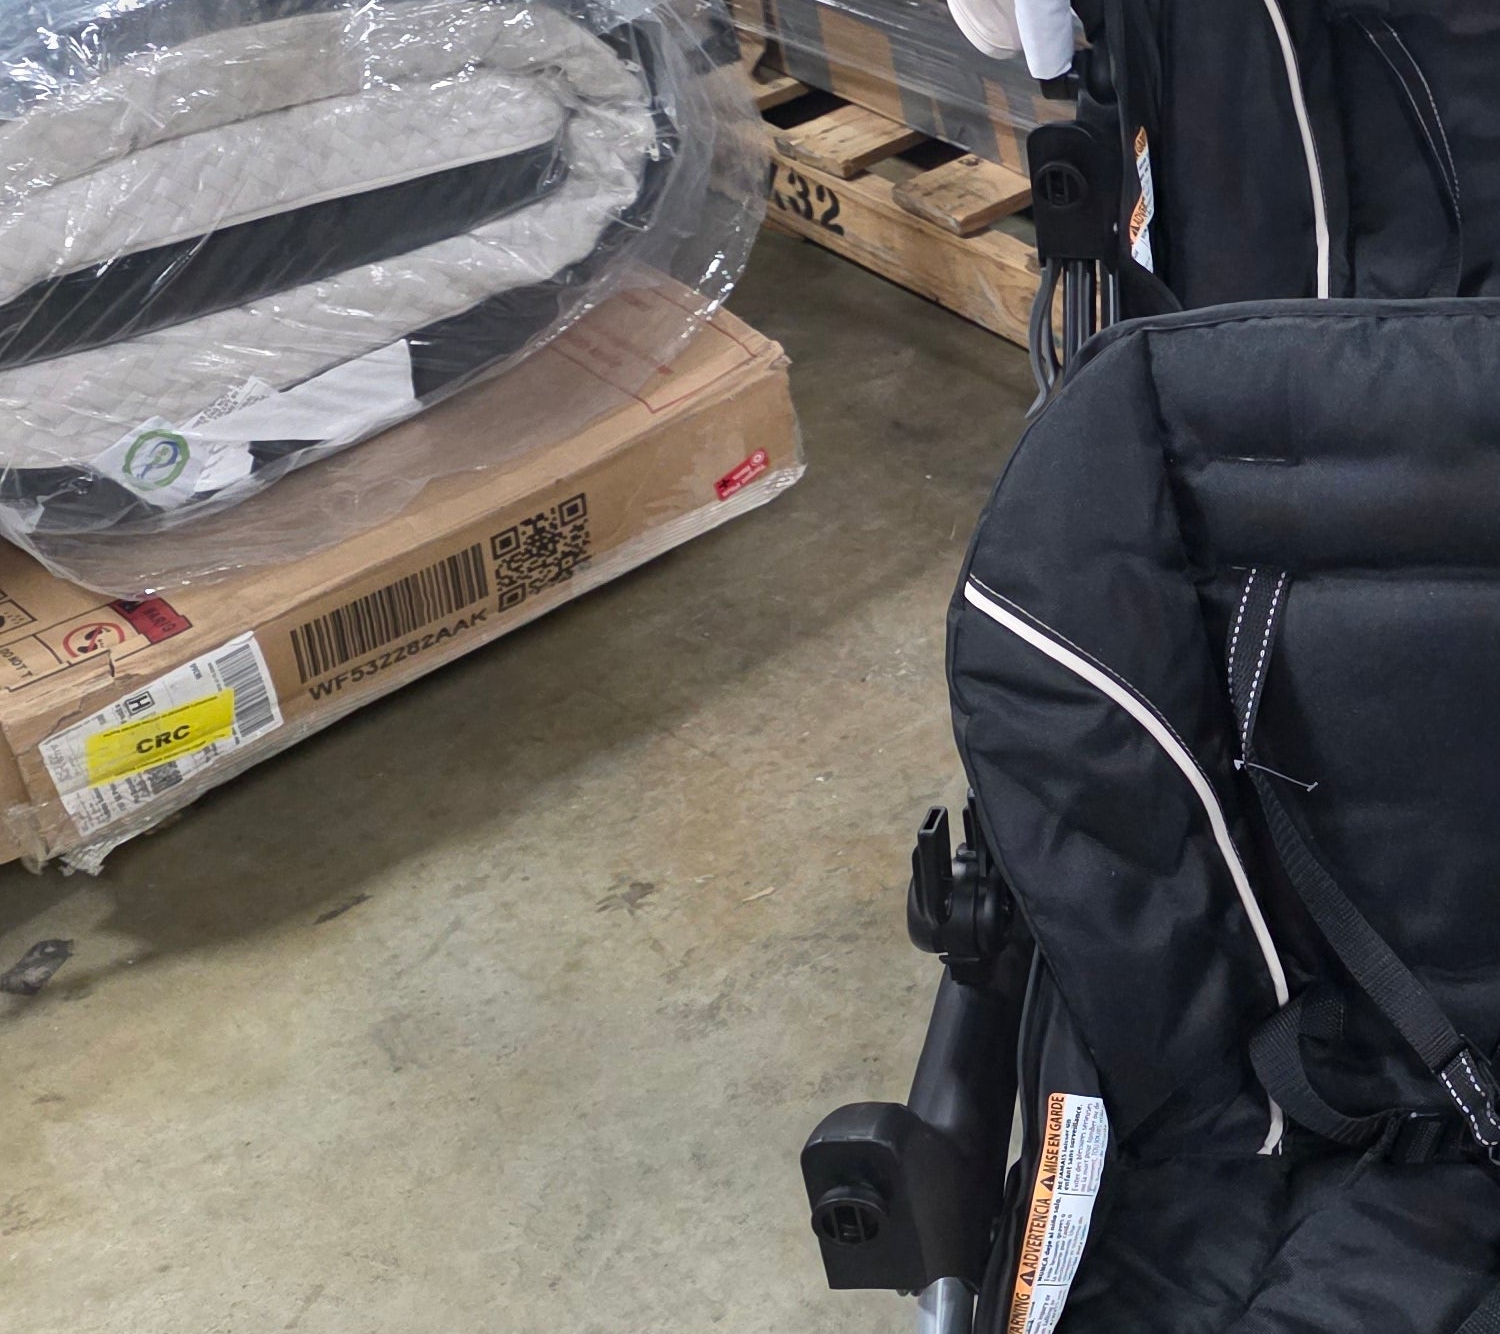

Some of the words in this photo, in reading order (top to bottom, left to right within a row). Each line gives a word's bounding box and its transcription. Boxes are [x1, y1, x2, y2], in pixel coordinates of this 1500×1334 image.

[309, 606, 489, 703] WF532282AAK
[135, 722, 192, 756] CRC
[1050, 1095, 1064, 1131] GARDE
[1048, 1133, 1060, 1147] EN
[1043, 1149, 1058, 1173] MISE
[1023, 1198, 1050, 1269] ADVERTENCIA
